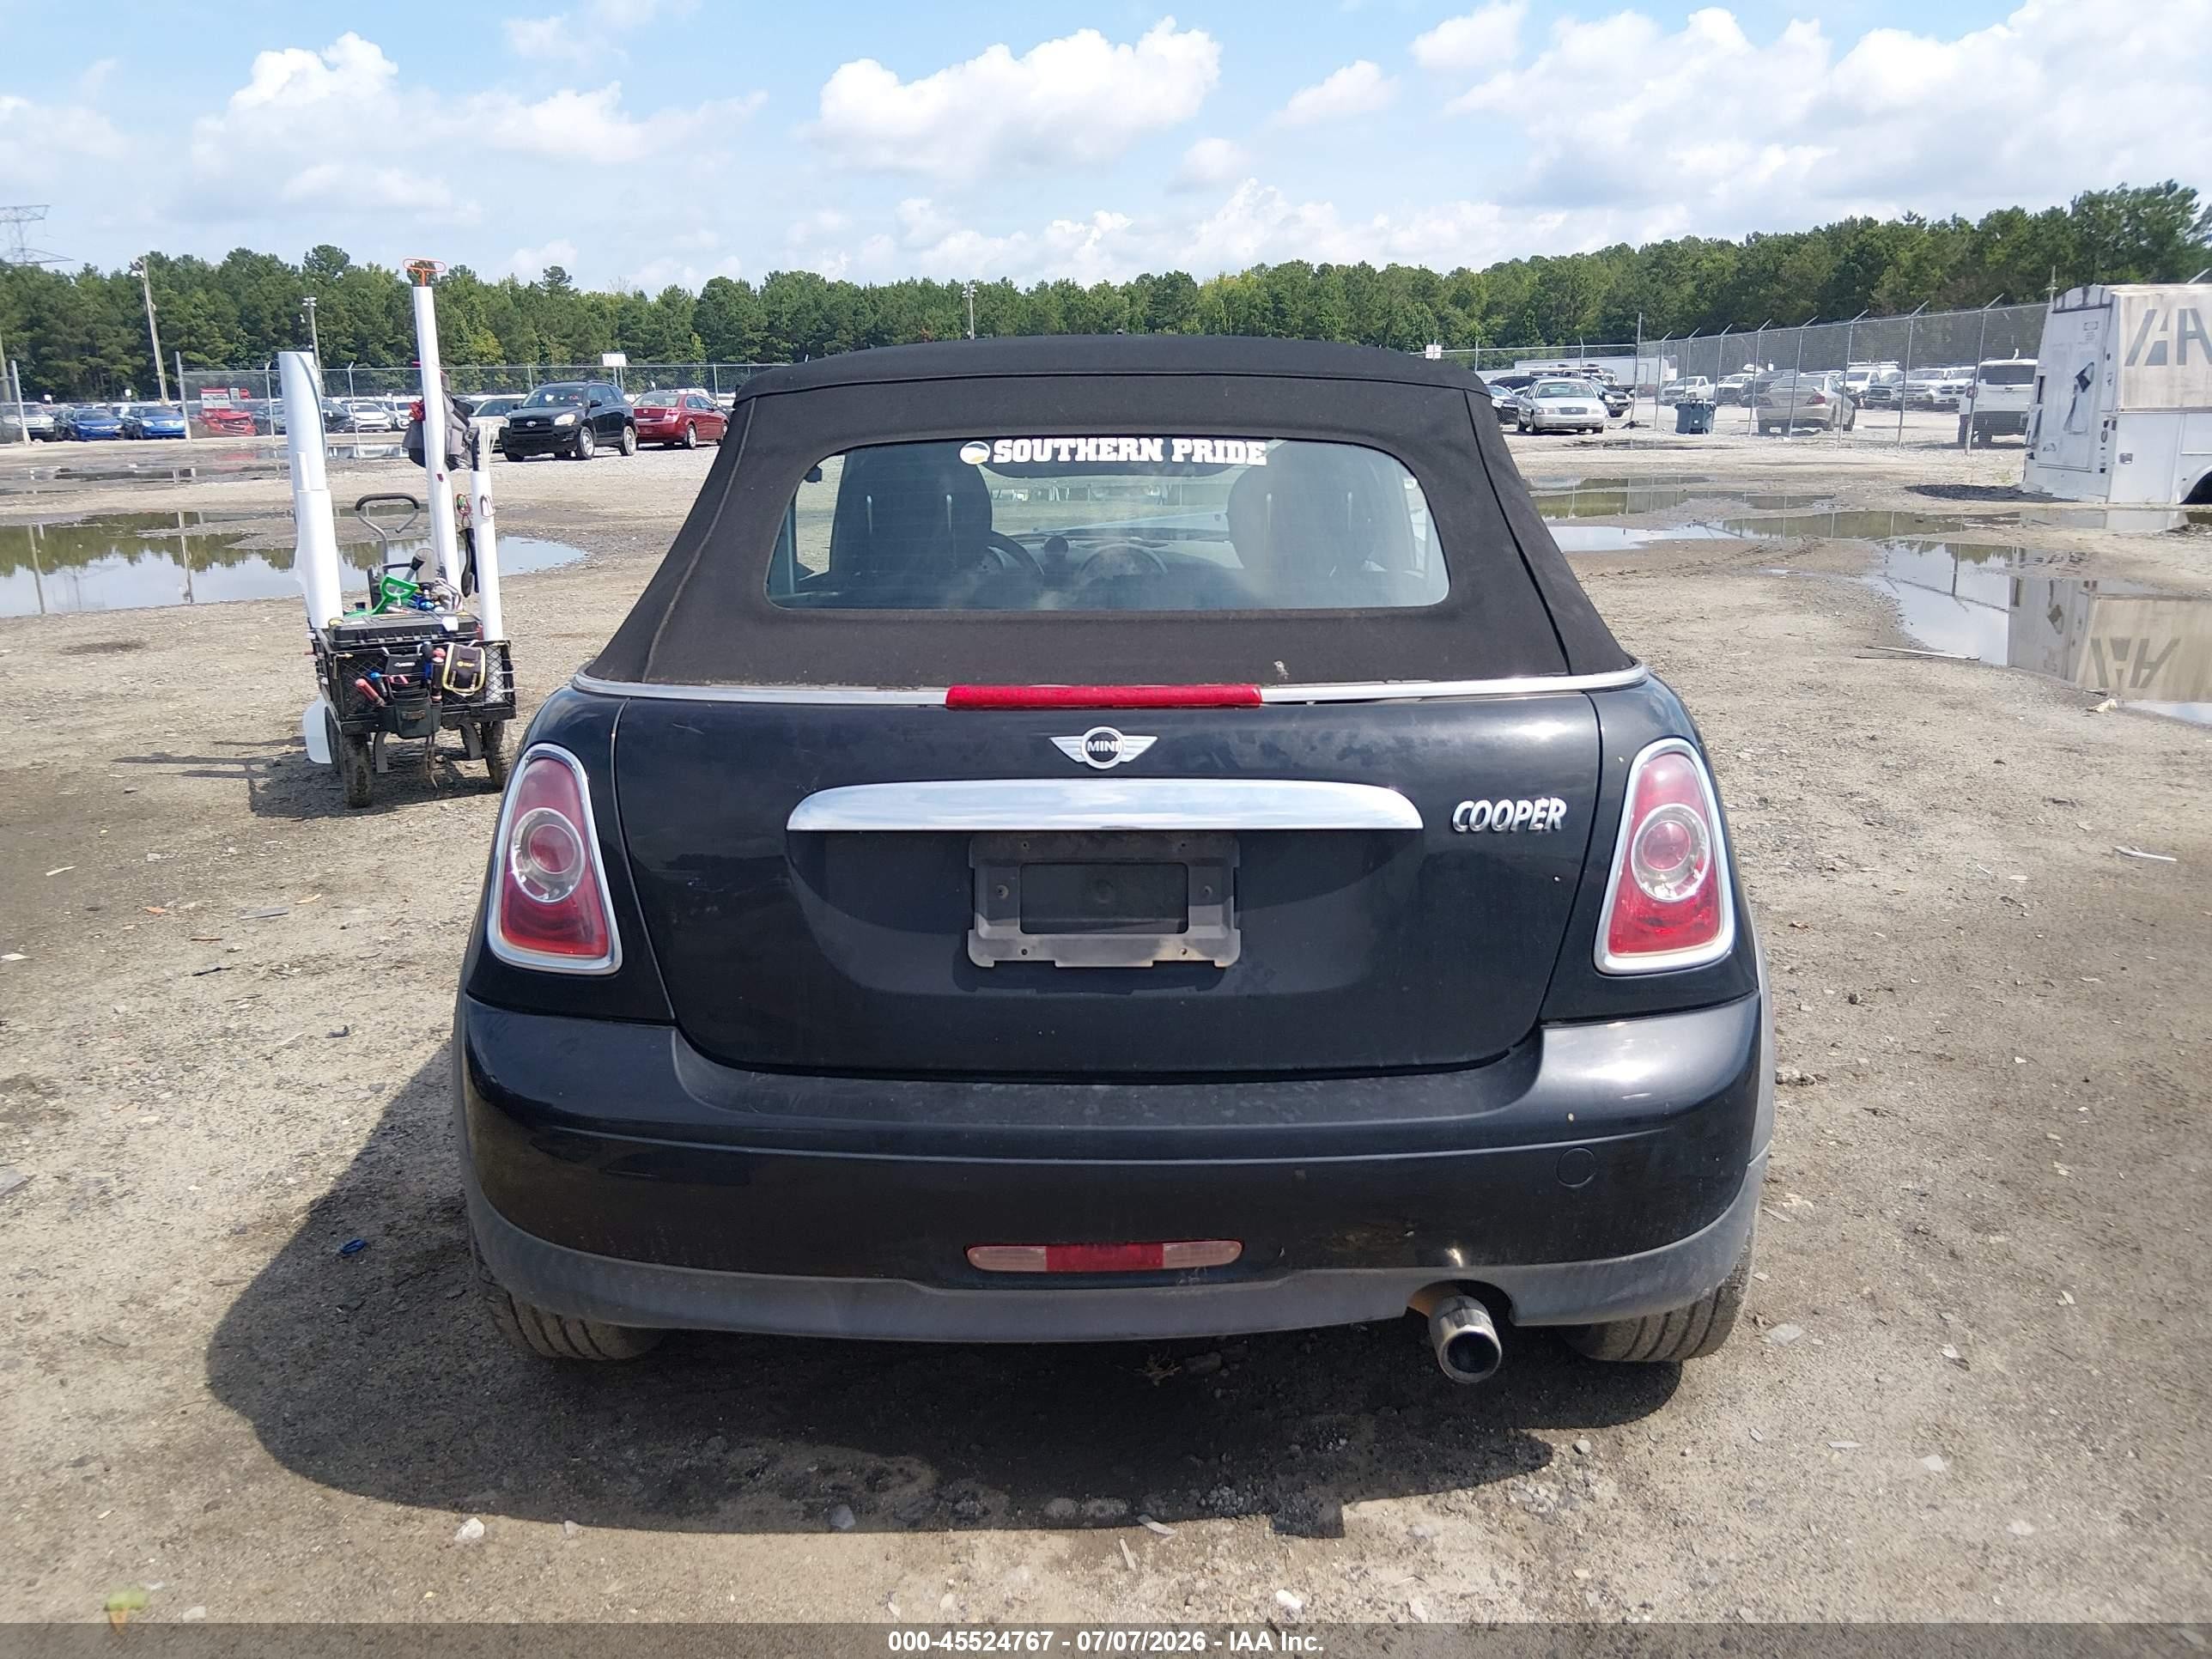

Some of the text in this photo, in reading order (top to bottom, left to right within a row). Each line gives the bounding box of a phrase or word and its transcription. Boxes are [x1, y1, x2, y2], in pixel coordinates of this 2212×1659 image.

[993, 438, 1267, 465] SOUTHERN PRIDE
[1087, 740, 1121, 752] MINI
[1452, 797, 1567, 832] COOPER
